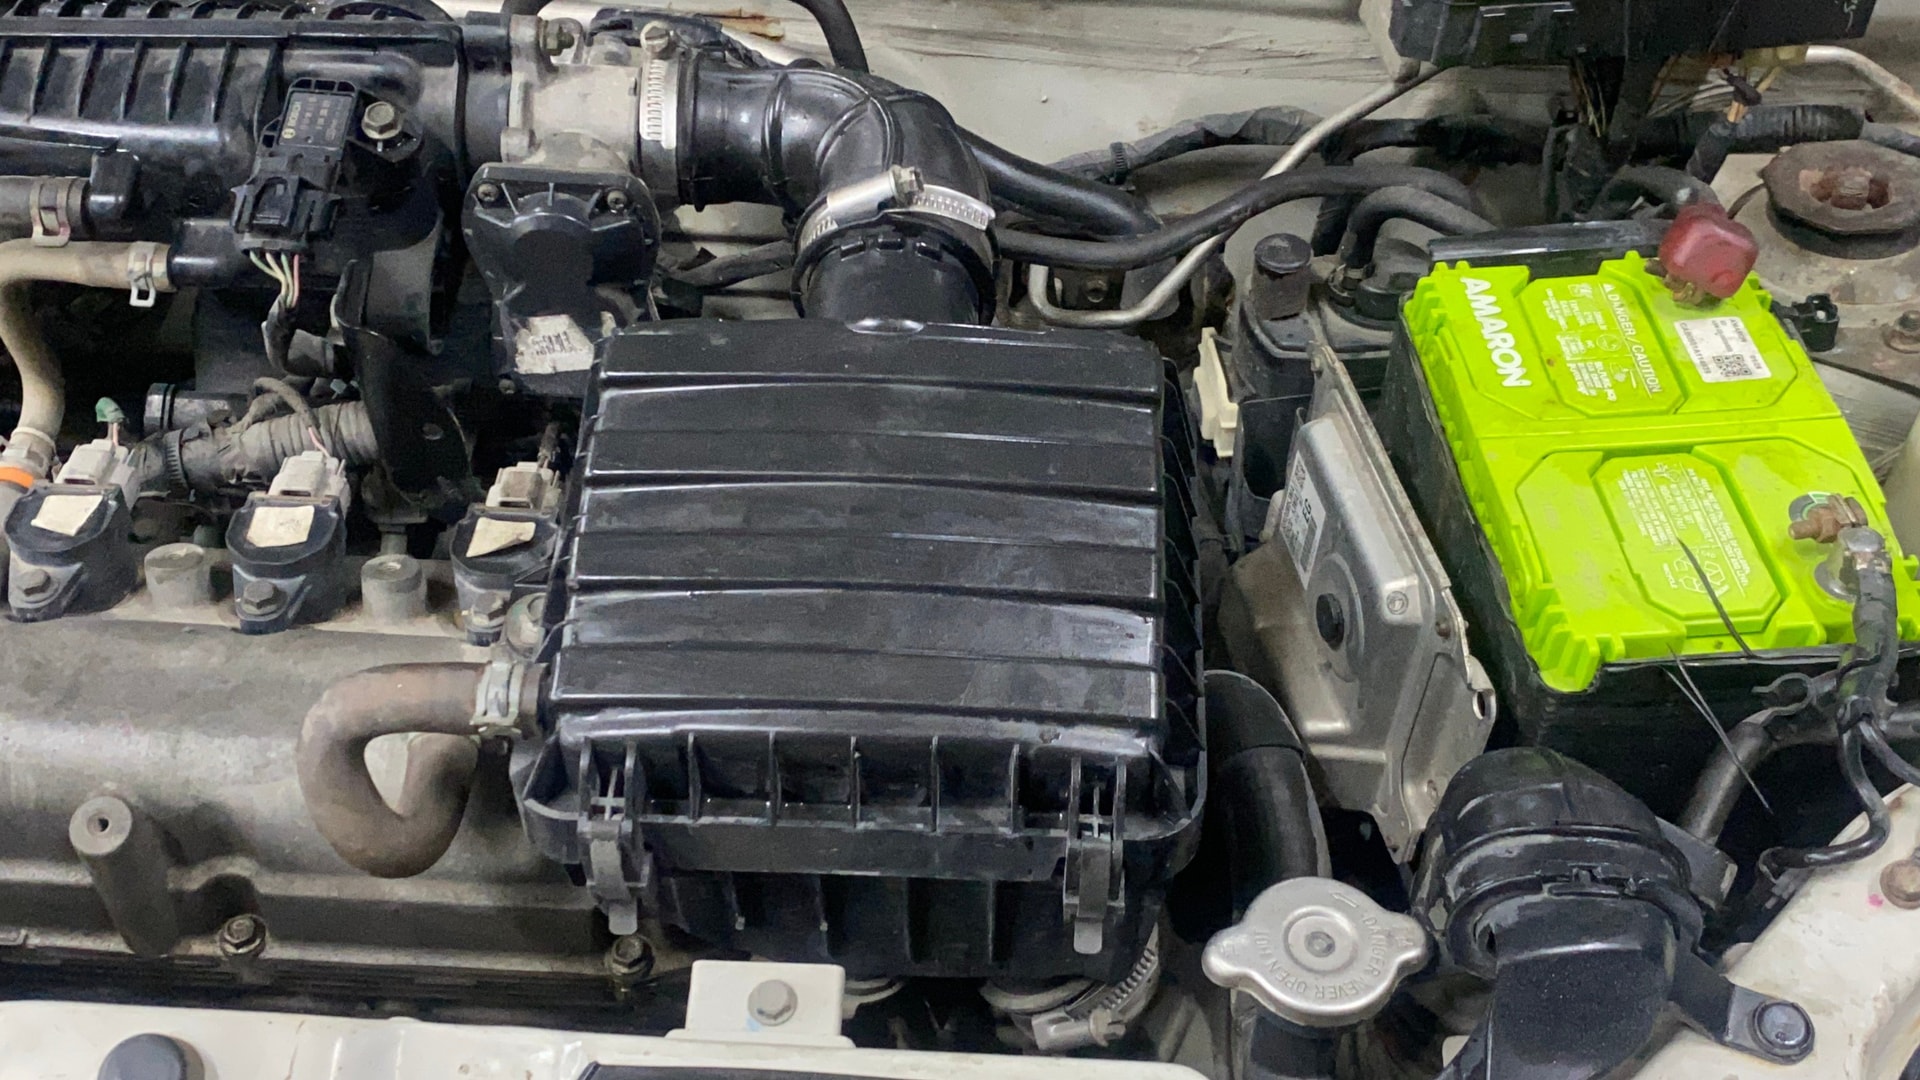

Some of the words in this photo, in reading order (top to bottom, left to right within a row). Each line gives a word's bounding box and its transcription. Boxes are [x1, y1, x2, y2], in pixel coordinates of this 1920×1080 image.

[1461, 277, 1531, 387] AMARON
[1607, 292, 1637, 336] DANGER
[1630, 343, 1663, 393] CAUTION
[1270, 960, 1308, 993] OPEN
[1363, 917, 1387, 977] DANGER
